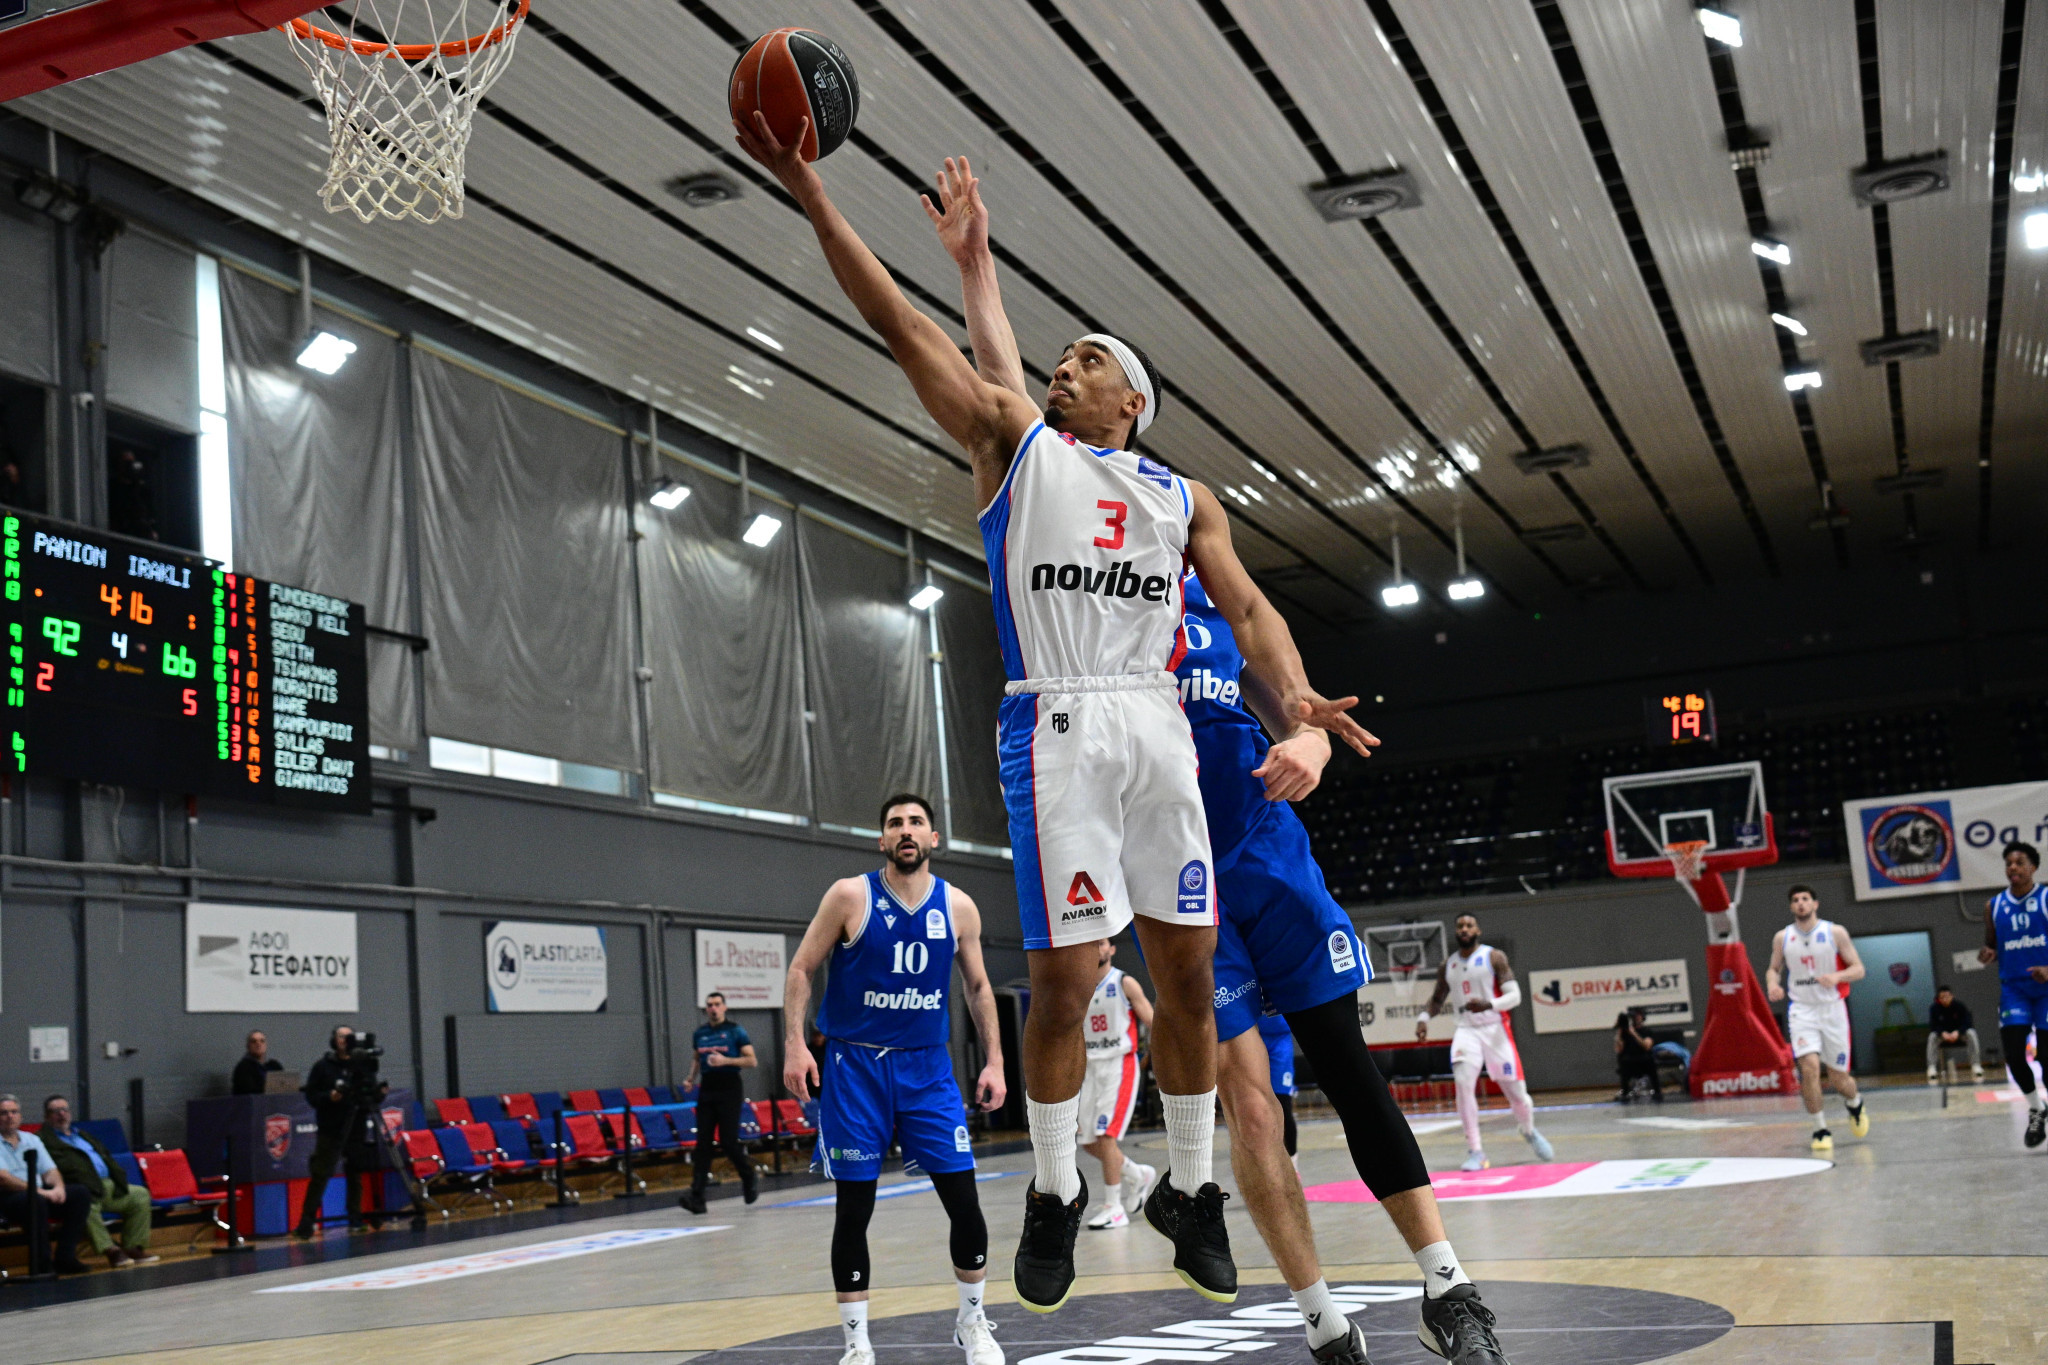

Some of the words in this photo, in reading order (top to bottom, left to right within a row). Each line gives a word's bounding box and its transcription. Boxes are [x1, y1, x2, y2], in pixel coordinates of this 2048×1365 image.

[1093, 499, 1128, 550] 3
[34, 532, 107, 568] PANION
[128, 554, 191, 588] IRAKLI
[1031, 561, 1172, 606] novibet
[43, 616, 81, 657] 92
[112, 632, 128, 659] 4
[162, 642, 197, 679] 66
[271, 638, 315, 663] SMITH
[36, 661, 54, 691] 2
[182, 688, 198, 716] 5
[1052, 713, 1069, 734] AB
[1672, 711, 1700, 740] 19
[2011, 912, 2030, 931] 19
[523, 943, 604, 962] PLASTICARTA
[704, 940, 723, 967] La
[727, 940, 781, 969] Pasteria
[890, 940, 929, 975] 10
[249, 954, 350, 977] ΣΤΕΦΑΤΟΥ
[1213, 986, 1228, 1000] co
[1213, 979, 1257, 1009] esources
[1462, 980, 1471, 995] 0
[1572, 973, 1680, 996] DRIVAPLAST
[864, 987, 943, 1010] novibet
[1090, 1014, 1108, 1033] 88
[1703, 1071, 1780, 1094] novibet
